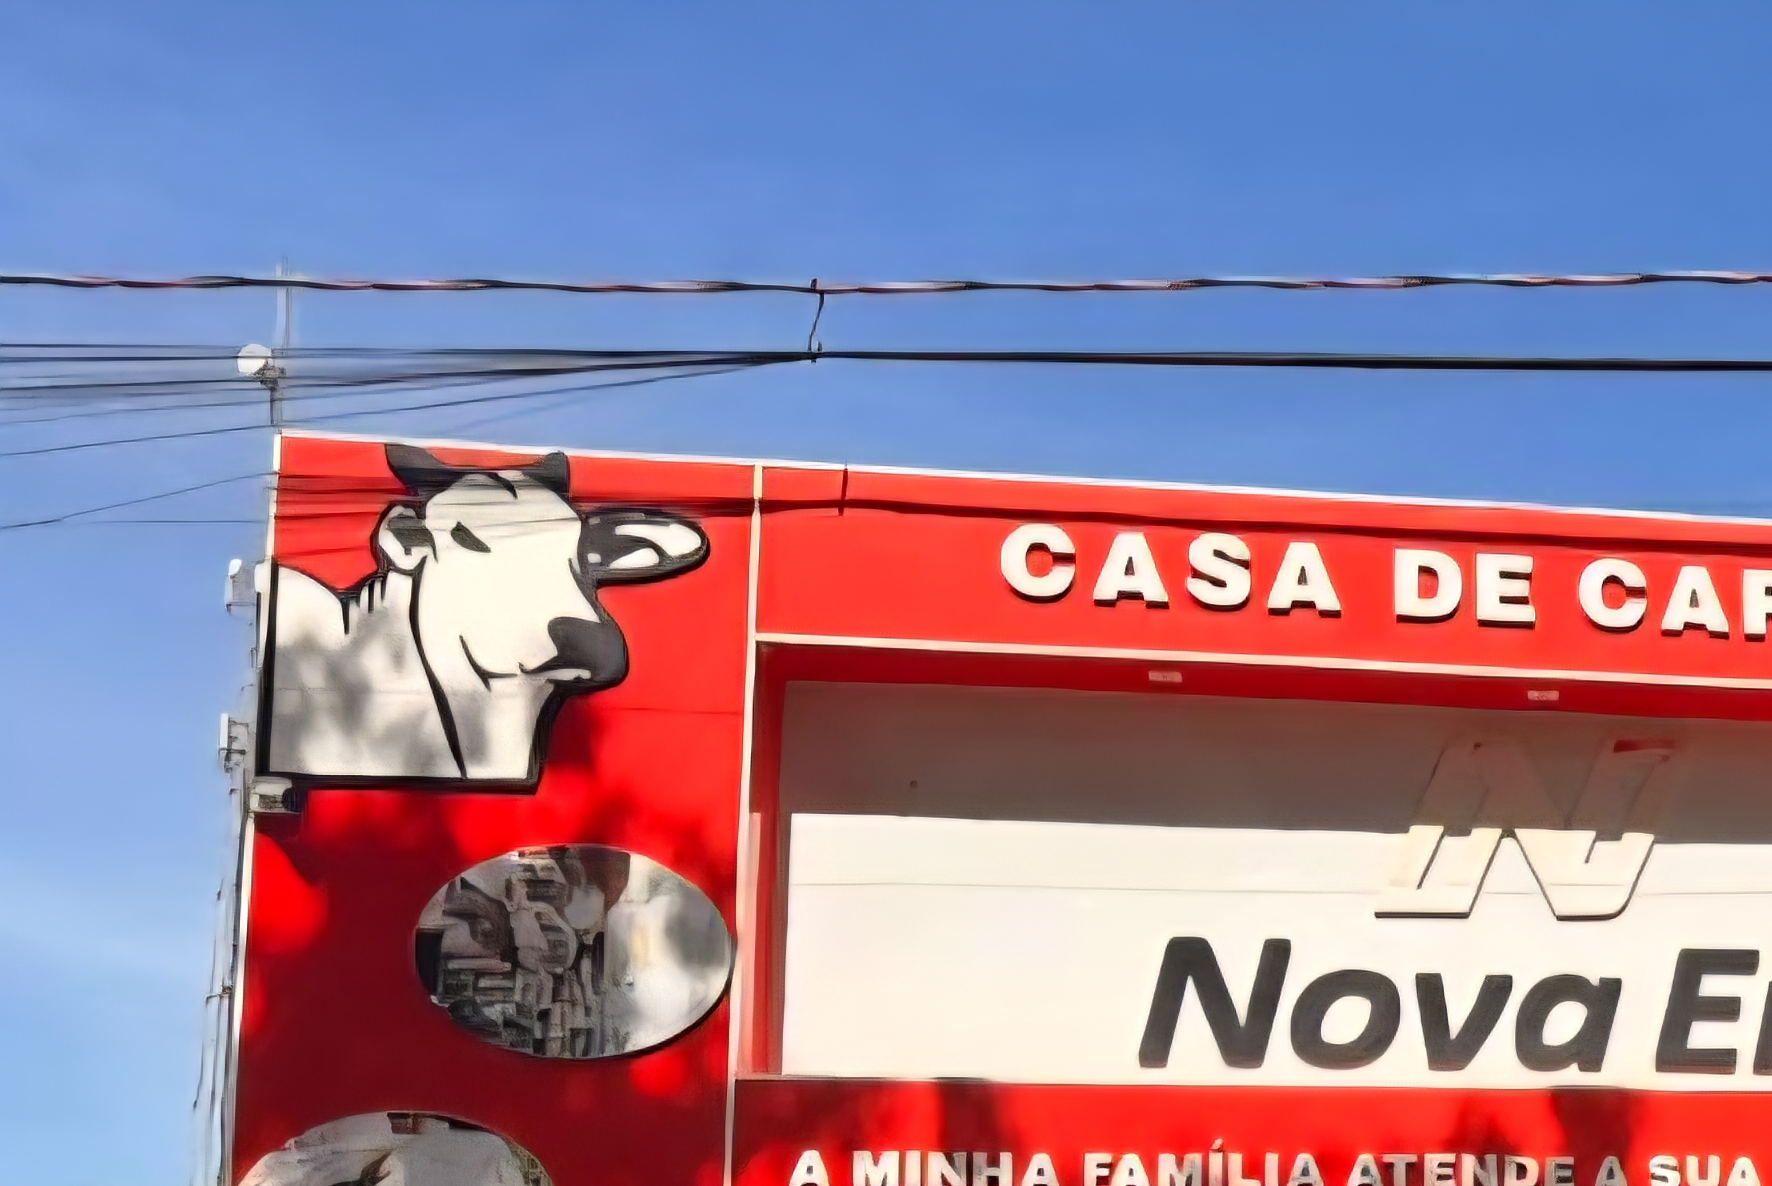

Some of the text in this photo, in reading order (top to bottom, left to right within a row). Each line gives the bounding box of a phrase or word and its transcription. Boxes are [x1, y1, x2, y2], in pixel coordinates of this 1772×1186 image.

[1000, 522, 1342, 616] CASA
[1394, 548, 1537, 630] DE
[1137, 936, 1622, 1072] Nova
